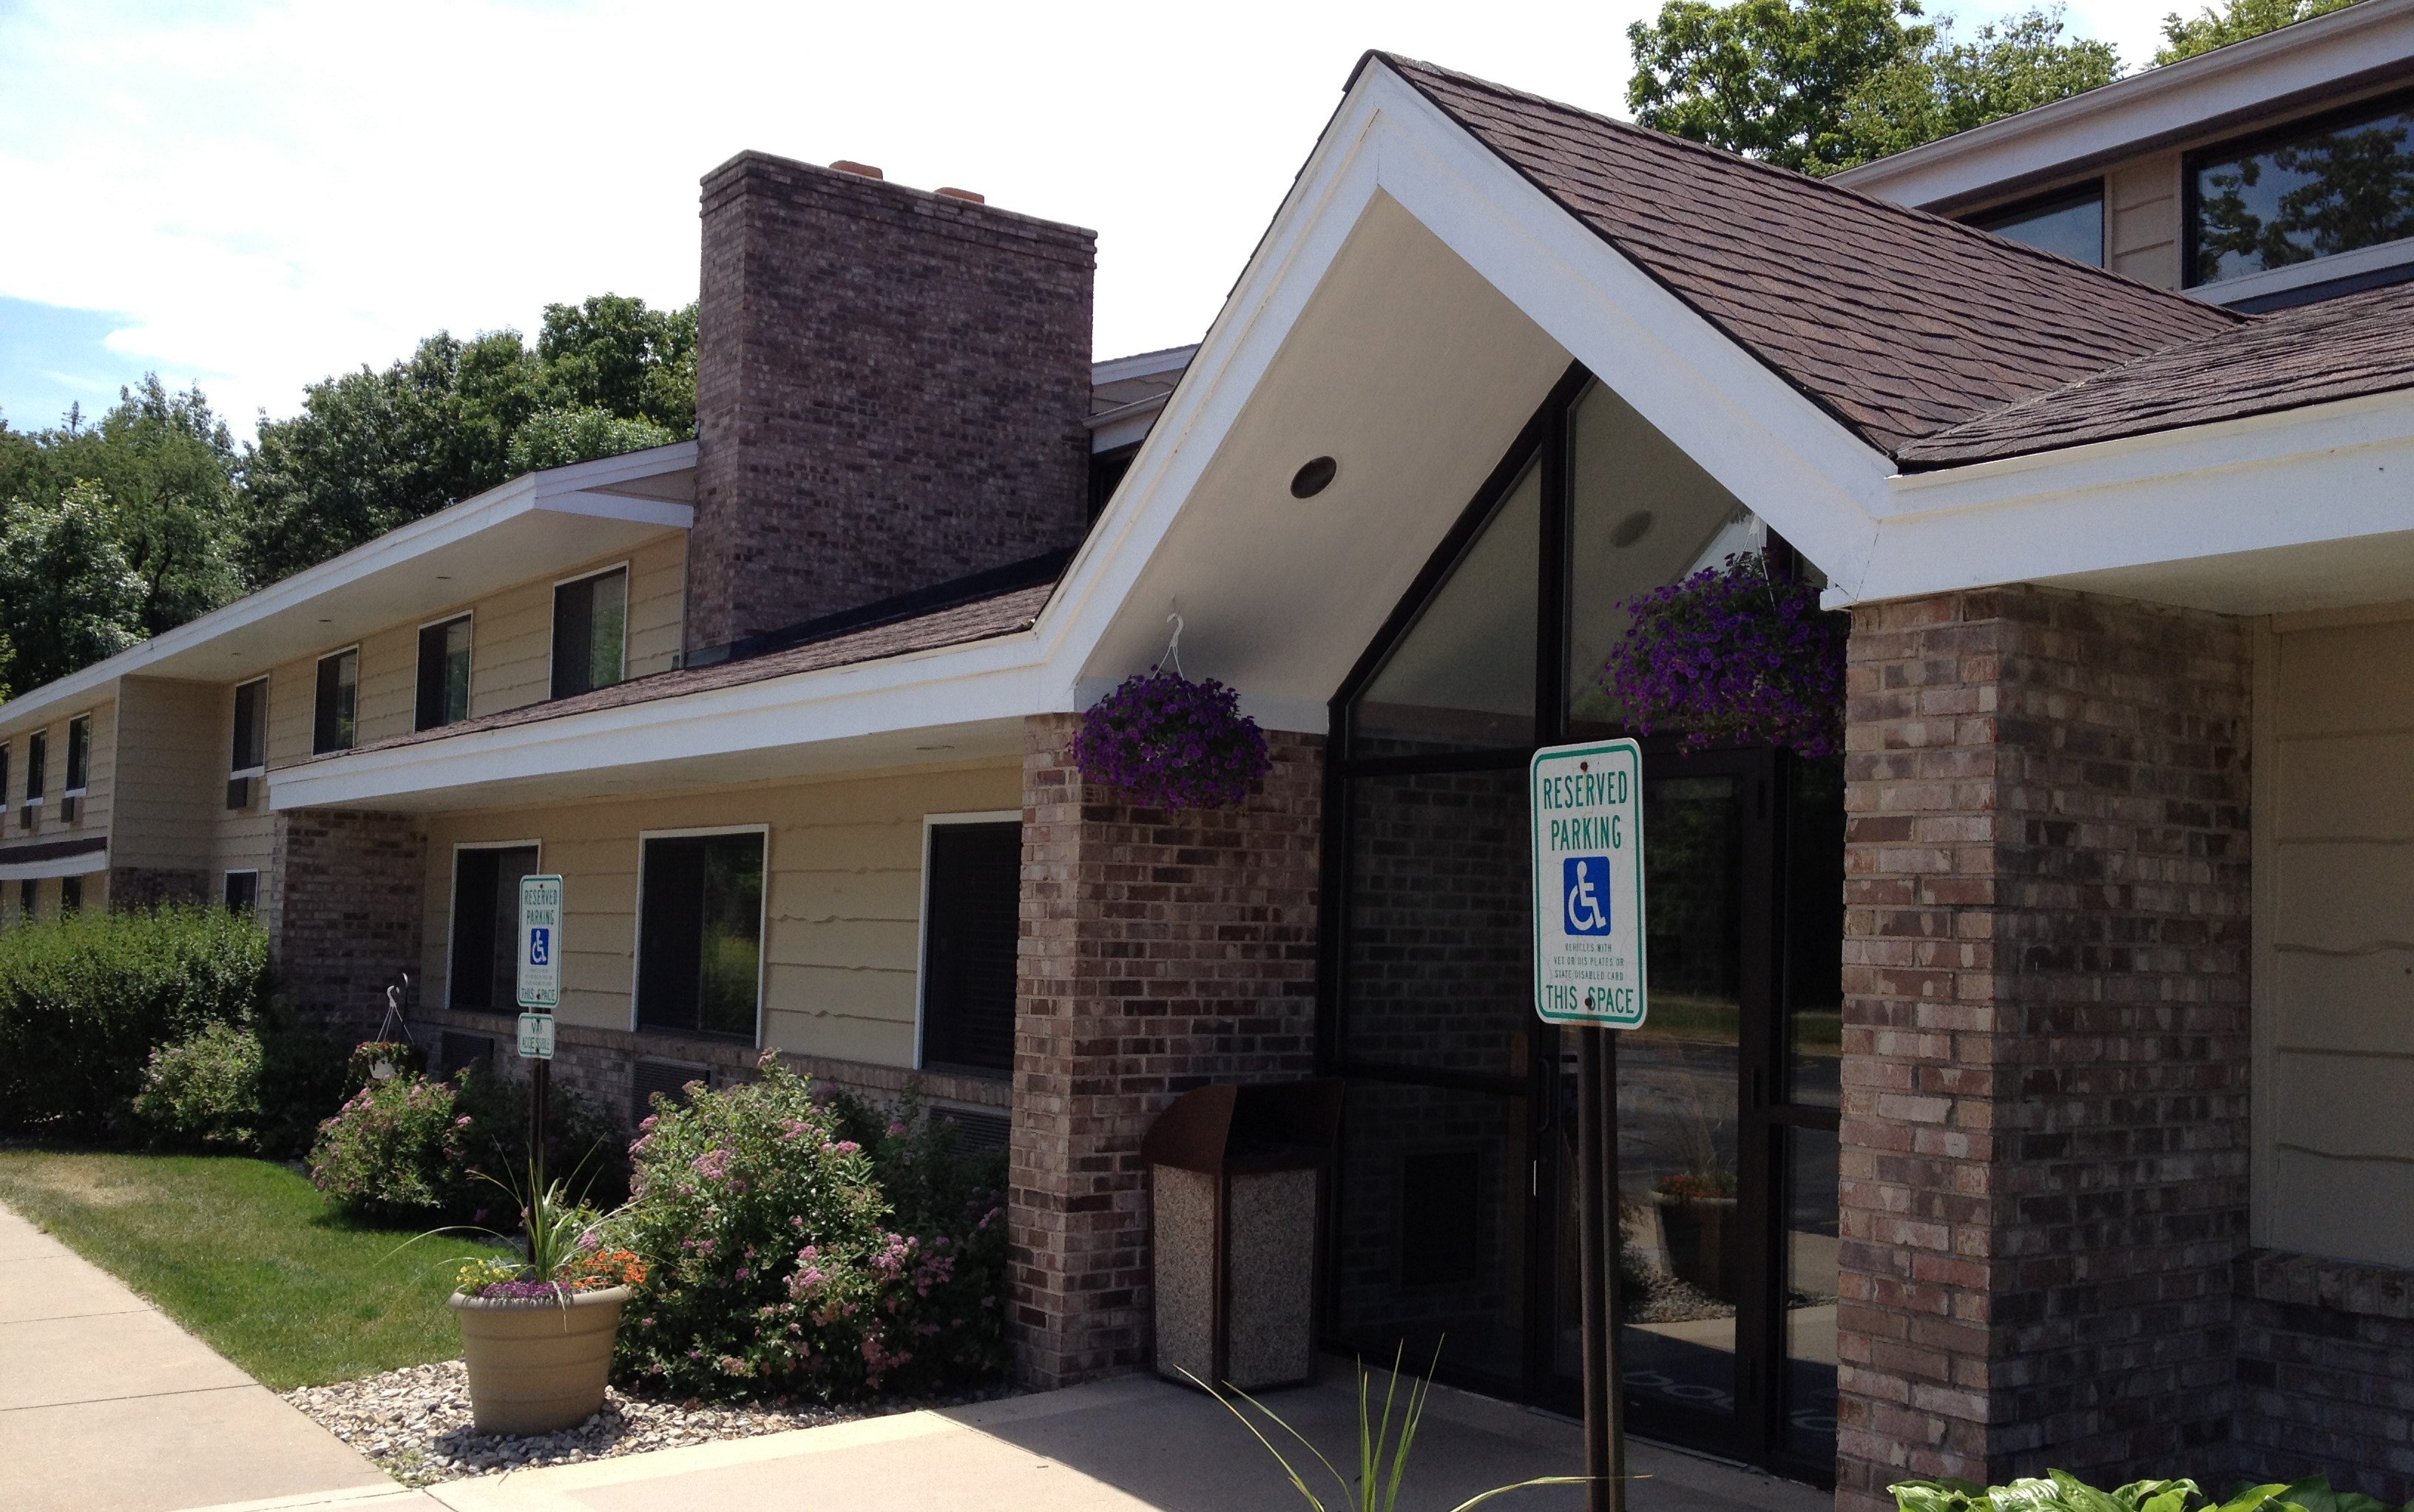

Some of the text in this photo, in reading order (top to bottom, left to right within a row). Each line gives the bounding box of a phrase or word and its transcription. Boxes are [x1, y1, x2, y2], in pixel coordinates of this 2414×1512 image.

[1544, 770, 1627, 810] RESERVED
[1551, 815, 1621, 851] PARKING
[524, 889, 558, 906] RESERVED
[527, 909, 554, 926] PARKING
[1565, 943, 1612, 952] VEHICLES WITH
[1553, 956, 1624, 967] VET OR DIS PLATES OR
[1555, 969, 1623, 981] STATE DISABLED CARD
[521, 987, 533, 1000] THIS
[1546, 985, 1634, 1014] THIS SPACE
